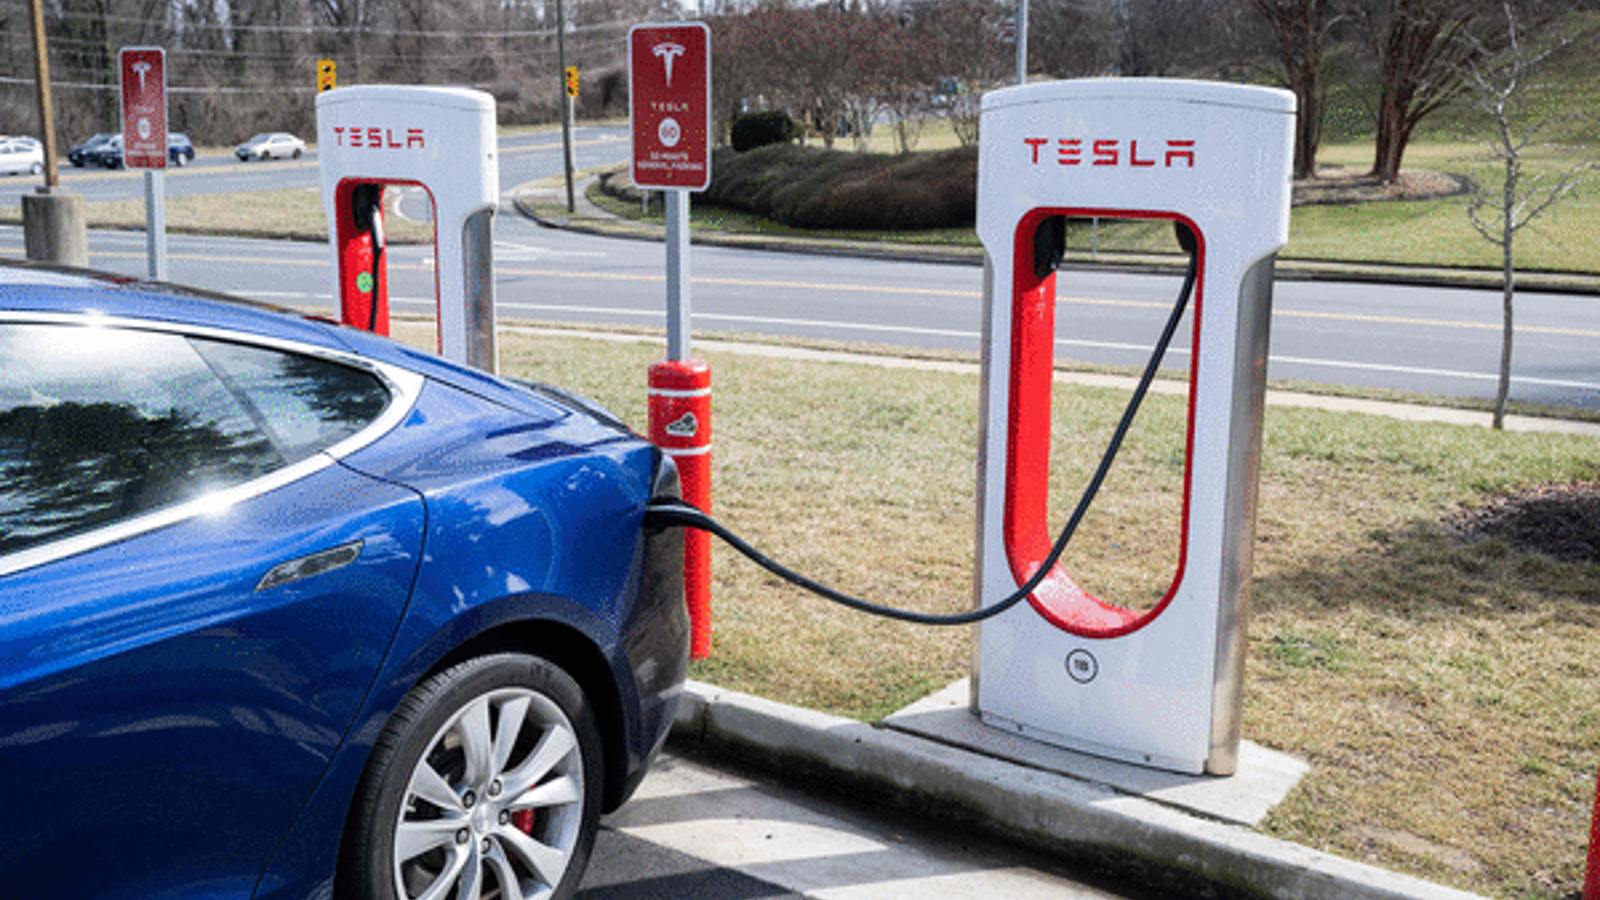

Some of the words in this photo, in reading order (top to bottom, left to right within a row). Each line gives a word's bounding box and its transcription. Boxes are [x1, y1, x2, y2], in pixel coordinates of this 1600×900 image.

[651, 102, 689, 112] TESLA
[333, 126, 425, 149] TESLA
[1023, 137, 1196, 167] TESLA
